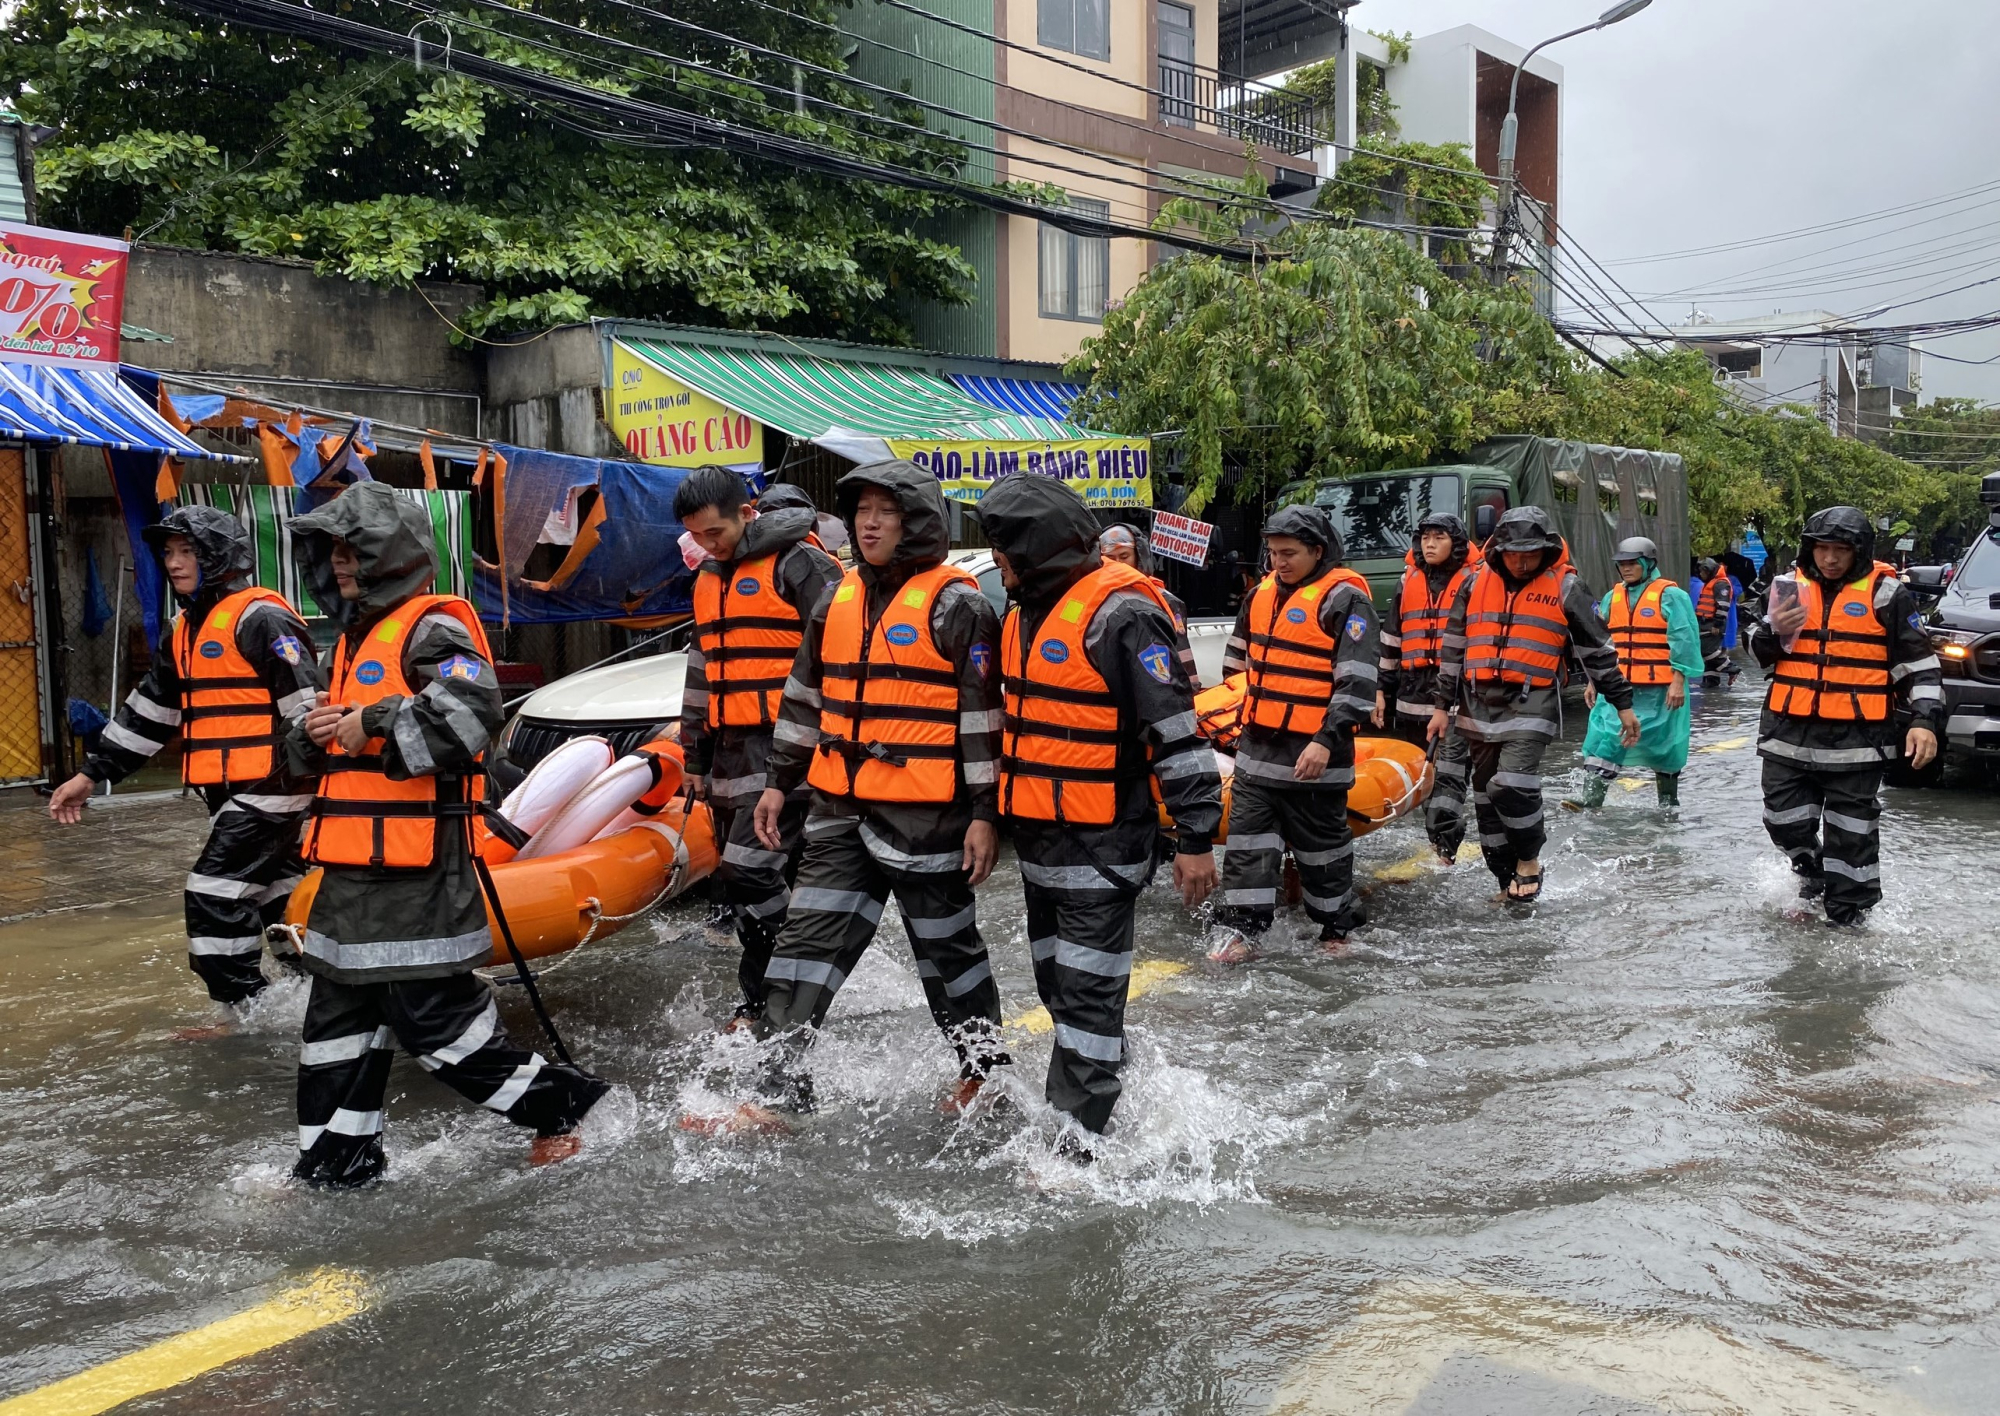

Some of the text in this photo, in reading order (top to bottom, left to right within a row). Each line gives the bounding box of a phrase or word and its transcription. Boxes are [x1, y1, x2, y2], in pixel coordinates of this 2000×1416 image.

[31, 340, 54, 352] hết
[57, 343, 99, 358] 15/10
[633, 398, 653, 414] CÔNG
[654, 395, 675, 411] TRỌN
[676, 389, 691, 407] GÓI
[625, 407, 753, 460] QUẢNG CÁO
[1027, 444, 1091, 480] BẢNG
[1096, 445, 1148, 484] HIỆU
[1088, 499, 1099, 507] LH:
[1150, 532, 1206, 559] PHOTOCOPY
[1525, 592, 1559, 607] CAND
